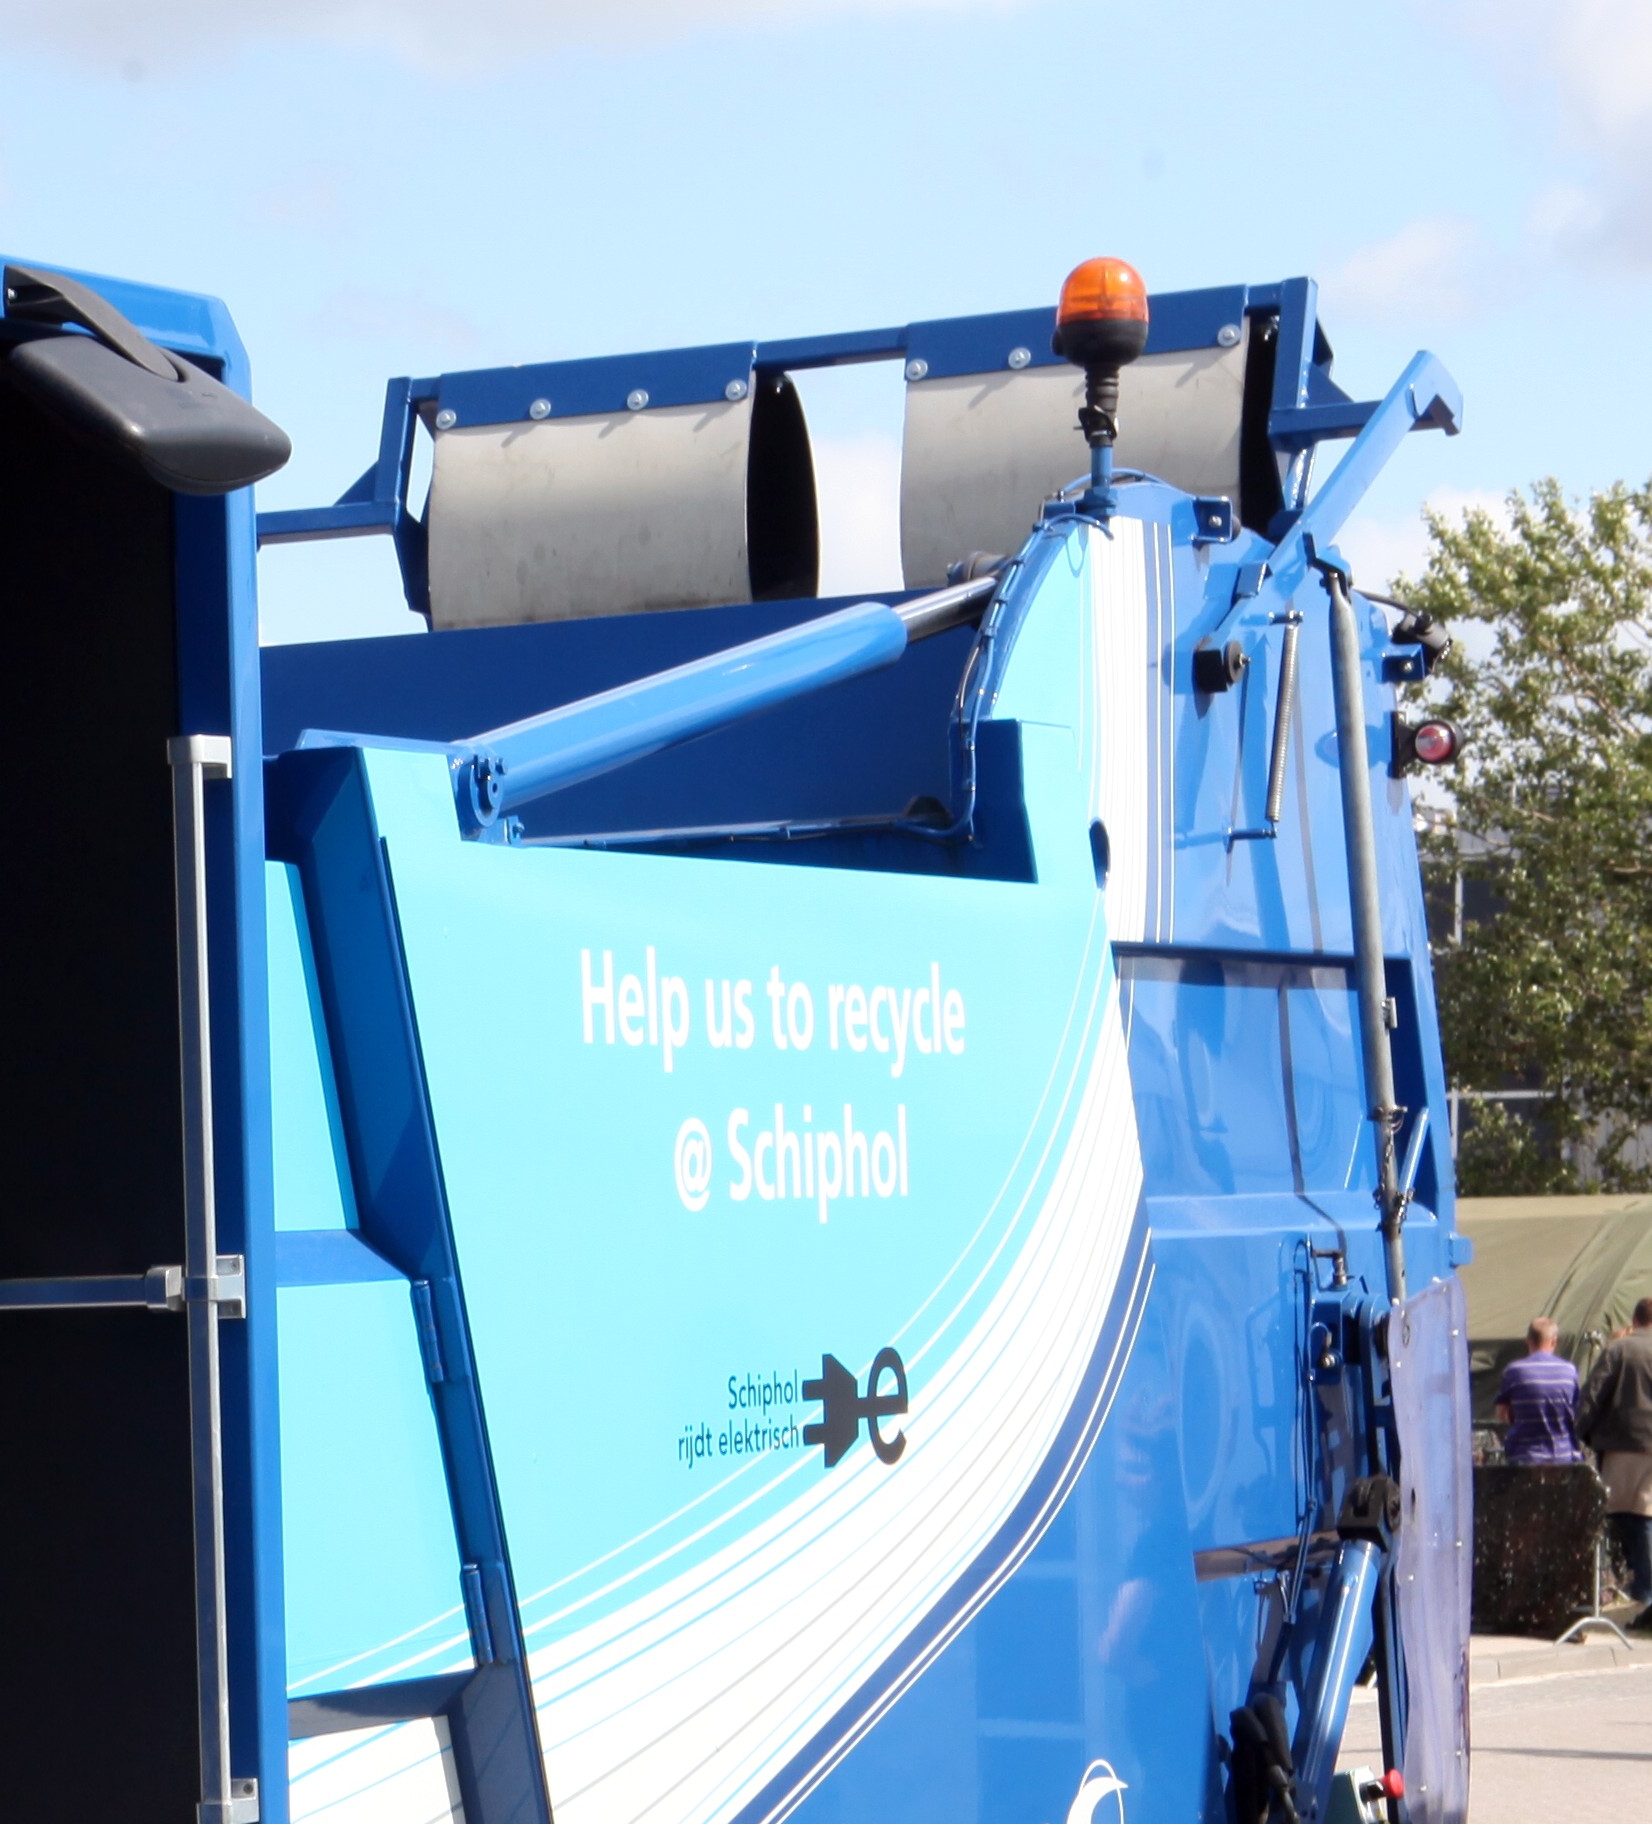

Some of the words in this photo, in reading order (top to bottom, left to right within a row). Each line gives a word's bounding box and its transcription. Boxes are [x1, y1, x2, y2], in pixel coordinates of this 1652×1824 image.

[580, 946, 690, 1073] Help
[705, 966, 756, 1051] us
[767, 964, 815, 1053] to
[829, 961, 967, 1079] recycle
[673, 1116, 713, 1213] @
[727, 1103, 910, 1224] Schiphol
[727, 1369, 800, 1411] Schiphol
[677, 1422, 714, 1470] rijdt
[718, 1418, 801, 1458] elektrisch
